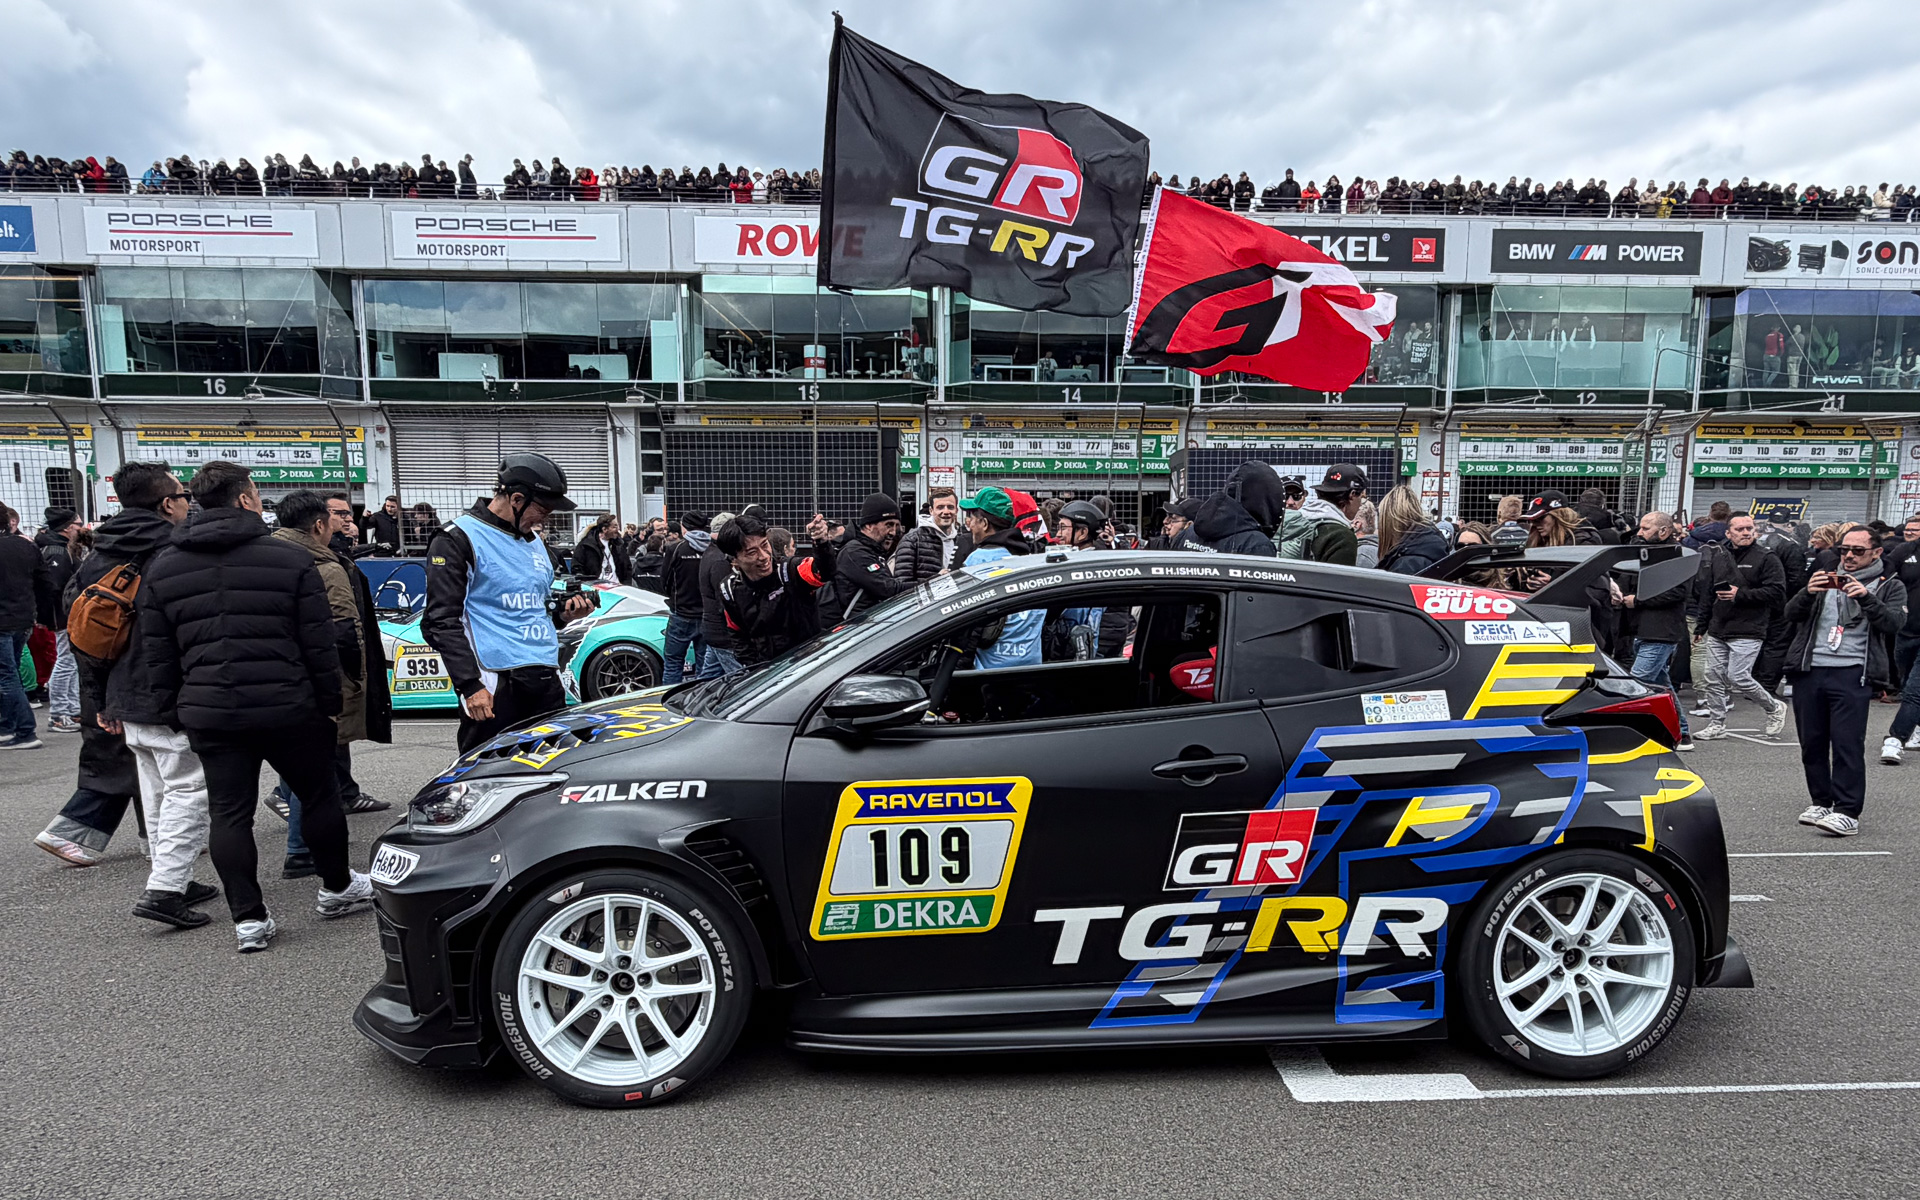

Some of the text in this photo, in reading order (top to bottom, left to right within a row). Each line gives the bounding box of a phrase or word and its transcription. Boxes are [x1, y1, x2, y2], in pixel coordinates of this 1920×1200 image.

[924, 145, 1078, 218] GR
[108, 212, 273, 228] PORSCHE
[415, 217, 577, 232] PORSCHE
[110, 239, 201, 252] MOTORSPORT
[417, 244, 506, 257] MOTORSPORT
[1509, 244, 1556, 260] BMW
[1618, 245, 1684, 261] POWER
[202, 378, 226, 395] 16
[798, 385, 819, 401] 15
[1061, 387, 1081, 403] 14
[1322, 391, 1342, 404] 13
[1576, 392, 1597, 406] 12
[1028, 441, 1042, 449] 101
[1056, 441, 1072, 449] 130
[1086, 442, 1100, 450] 777
[1160, 435, 1177, 443] BOX
[1651, 439, 1666, 447] BOX
[187, 449, 199, 457] 99
[221, 449, 238, 458] 410
[256, 450, 276, 458] 445
[293, 450, 312, 458] 925
[347, 452, 364, 466] 16
[1402, 447, 1417, 460] 13
[1651, 448, 1666, 461] 12
[1703, 447, 1713, 455] 47
[1757, 447, 1770, 455] 110
[1886, 449, 1898, 462] 11
[1085, 567, 1142, 580] D.TOYODA
[1165, 566, 1220, 577] H.ISHIURA
[1242, 569, 1296, 583] K.OSHIMA
[1019, 574, 1063, 590] MORIZO
[951, 588, 997, 611] H.NARUSE
[1425, 587, 1473, 599] sport
[1423, 595, 1516, 614] auto
[520, 624, 551, 640] 702
[407, 658, 440, 676] 939
[411, 681, 445, 690] DEKRA
[558, 780, 707, 804] FALKEN
[869, 791, 1002, 809] RAVENOL
[868, 825, 971, 889] 109
[1172, 840, 1304, 885] GR
[1484, 868, 1548, 938] POTENZA
[873, 899, 981, 929] DEKRA
[1034, 896, 1449, 965] TG-RR
[688, 908, 734, 992] POTENZA
[1627, 984, 1688, 1062] BRIDGESTONE
[498, 991, 553, 1080] BRIDGESTONE
